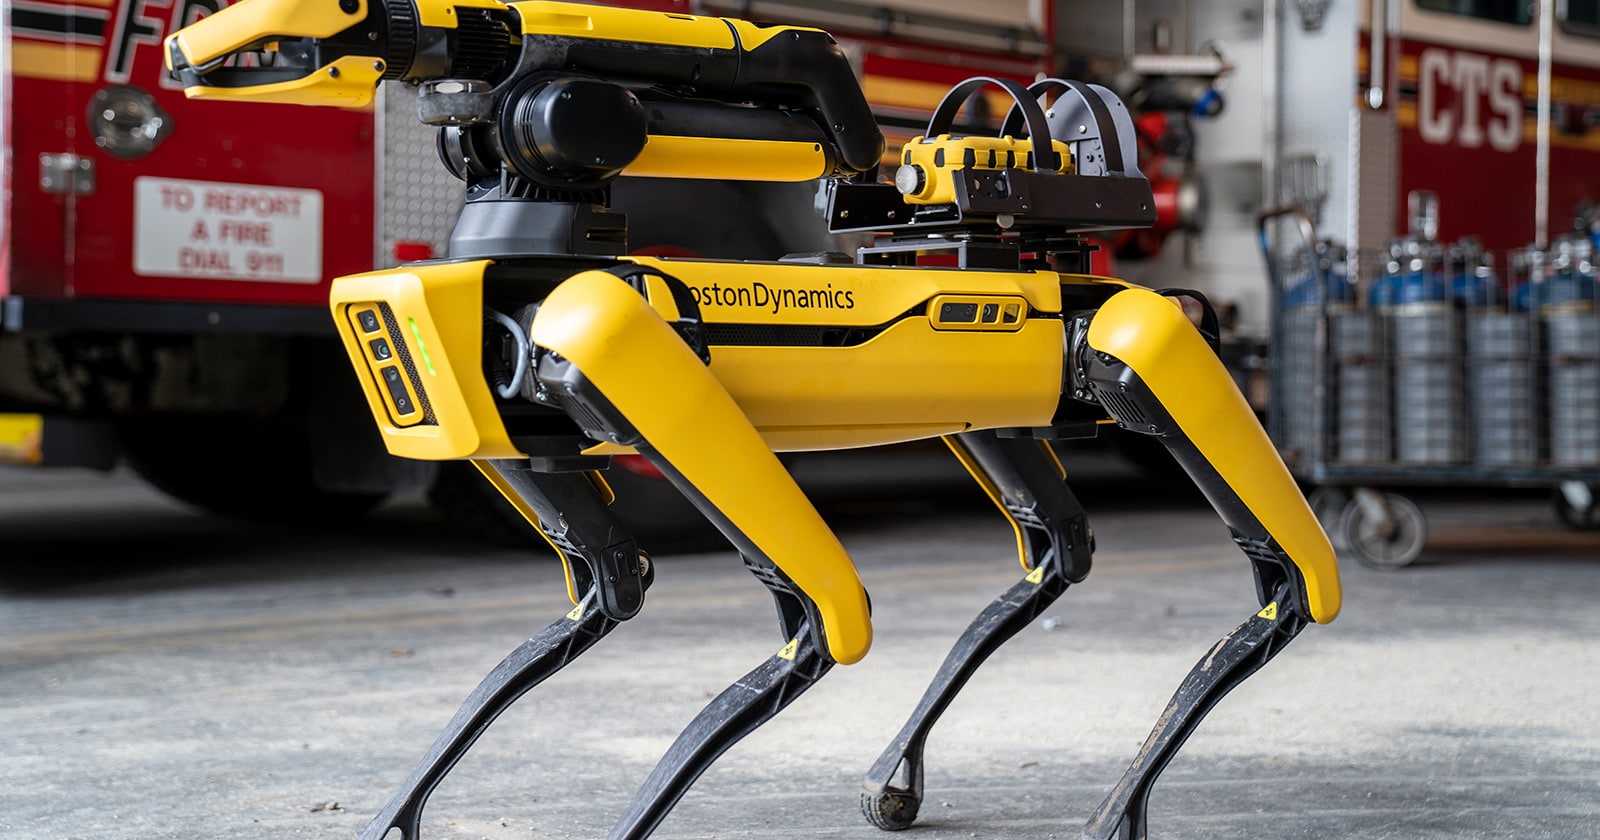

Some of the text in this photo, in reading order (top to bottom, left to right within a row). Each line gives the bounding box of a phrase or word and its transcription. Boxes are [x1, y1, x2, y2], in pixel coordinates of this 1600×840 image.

[1419, 48, 1523, 152] CTS
[160, 185, 302, 218] TO REPORT
[190, 217, 272, 246] A FIRE
[178, 246, 285, 275] DIAL 911
